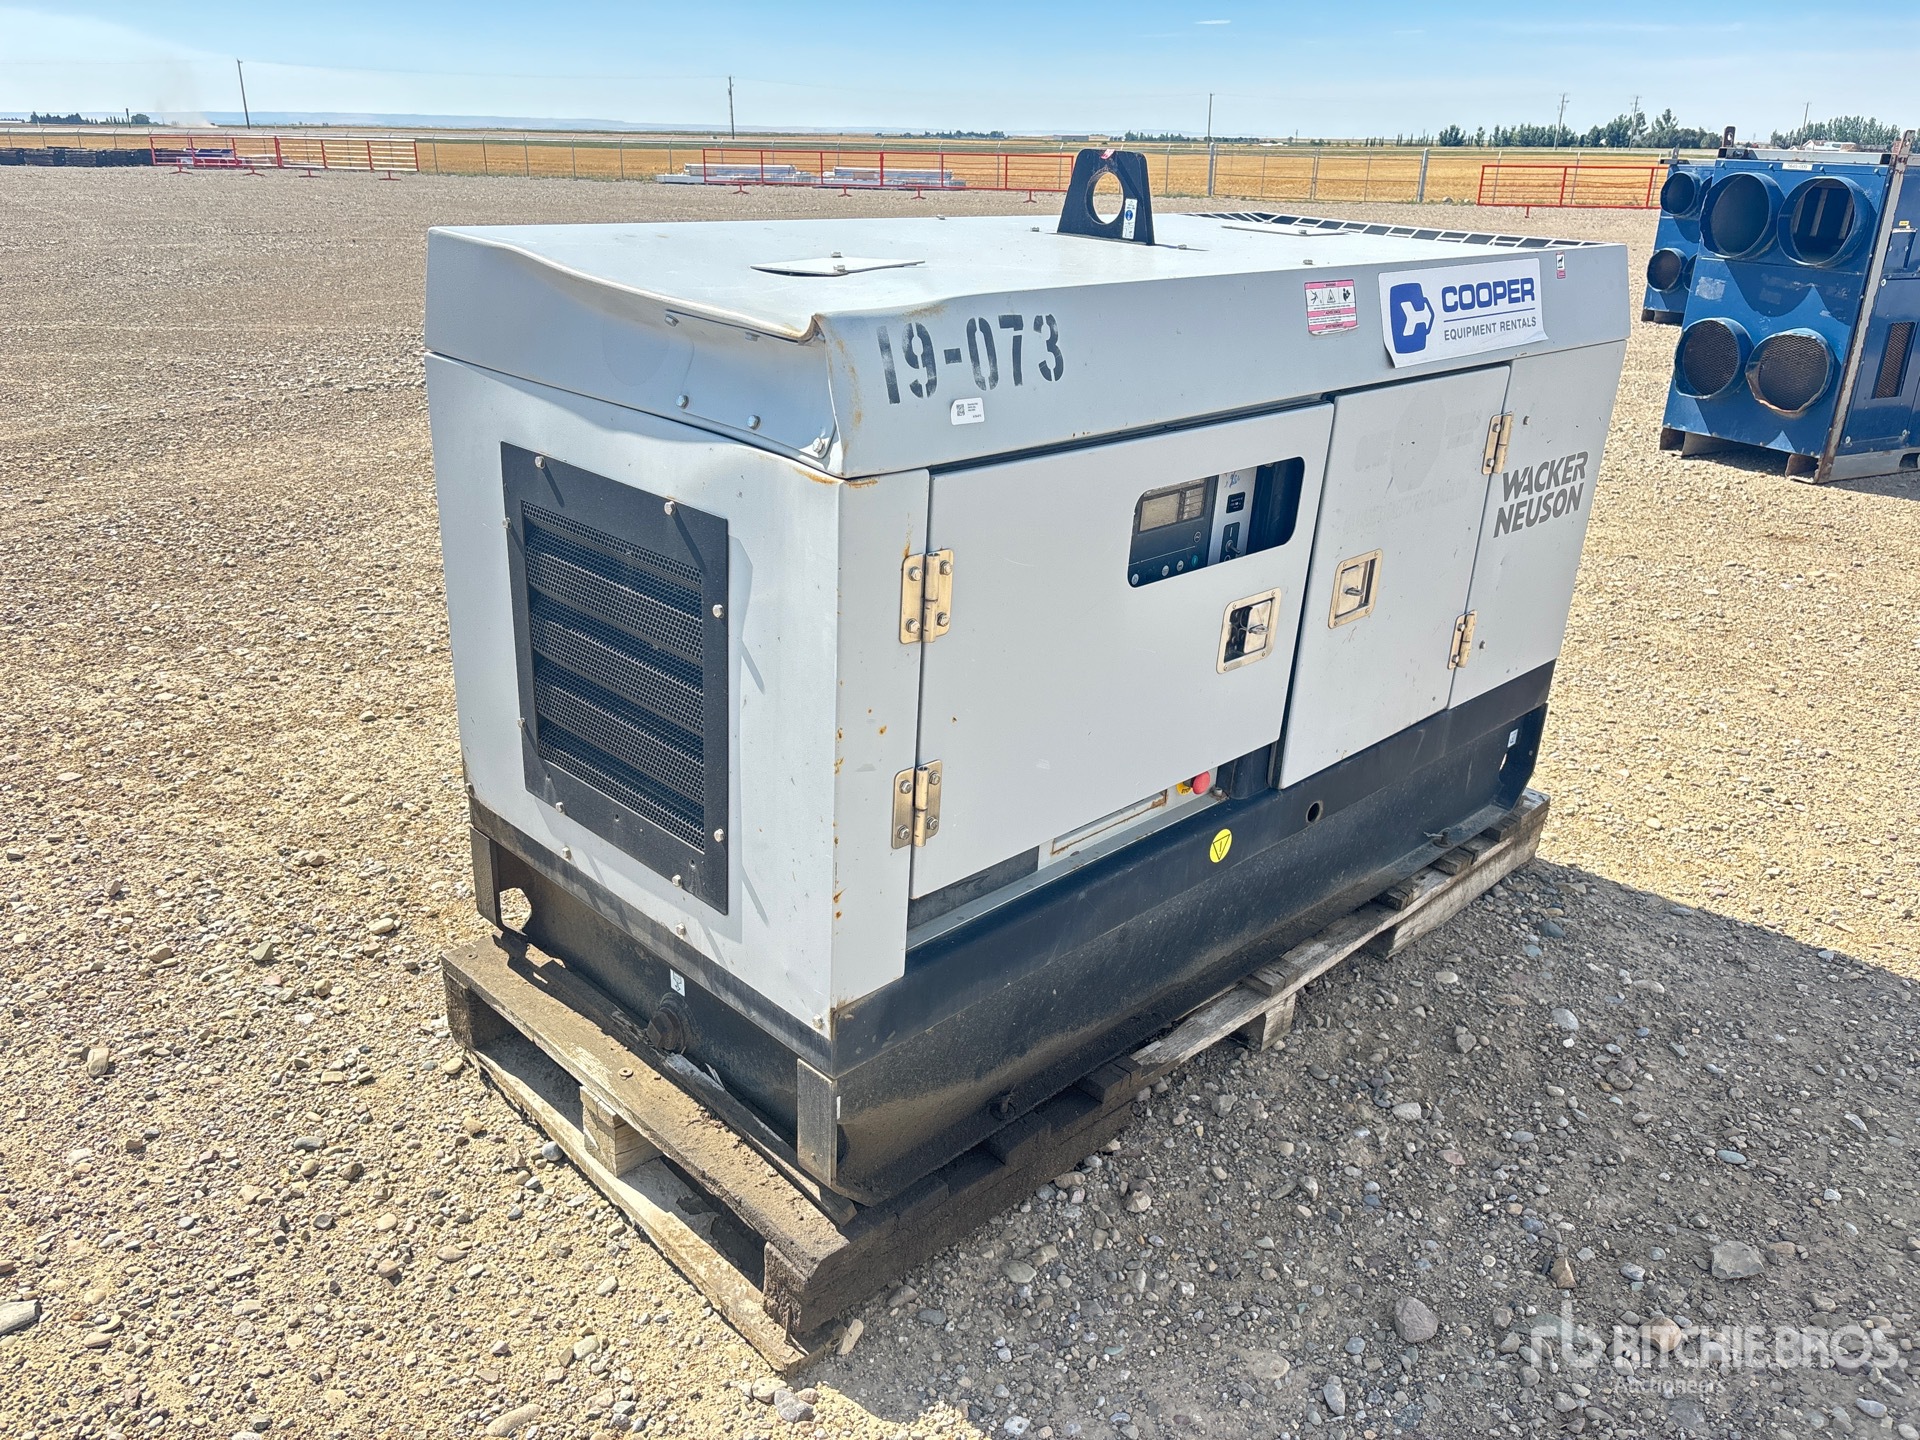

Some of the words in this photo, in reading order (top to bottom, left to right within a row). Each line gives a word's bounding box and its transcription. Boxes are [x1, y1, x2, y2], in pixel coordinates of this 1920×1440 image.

[1441, 277, 1535, 313] COOPER
[1444, 322, 1497, 341] EQUIPMENT
[1500, 316, 1537, 332] RENTALS
[876, 313, 1064, 404] 19-073
[1502, 451, 1589, 502] WACKER
[1493, 482, 1584, 538] NEUSON
